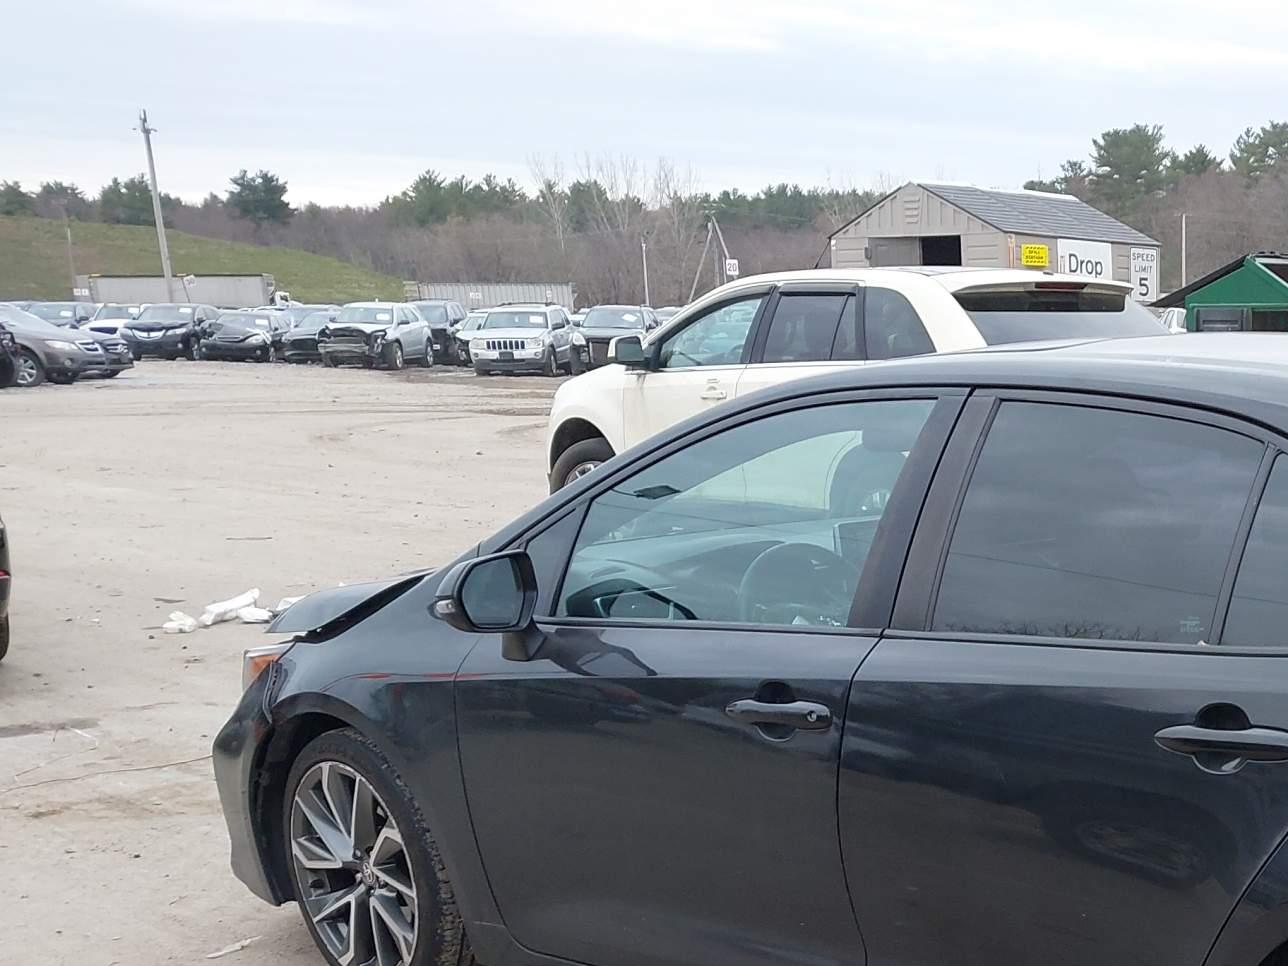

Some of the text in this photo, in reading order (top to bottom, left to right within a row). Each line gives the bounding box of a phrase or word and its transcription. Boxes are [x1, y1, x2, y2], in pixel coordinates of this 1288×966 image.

[1132, 252, 1155, 262] SPEED
[727, 262, 737, 272] 20
[1068, 253, 1103, 278] Drop
[1134, 265, 1152, 273] LIMIT
[1138, 277, 1149, 297] 5
